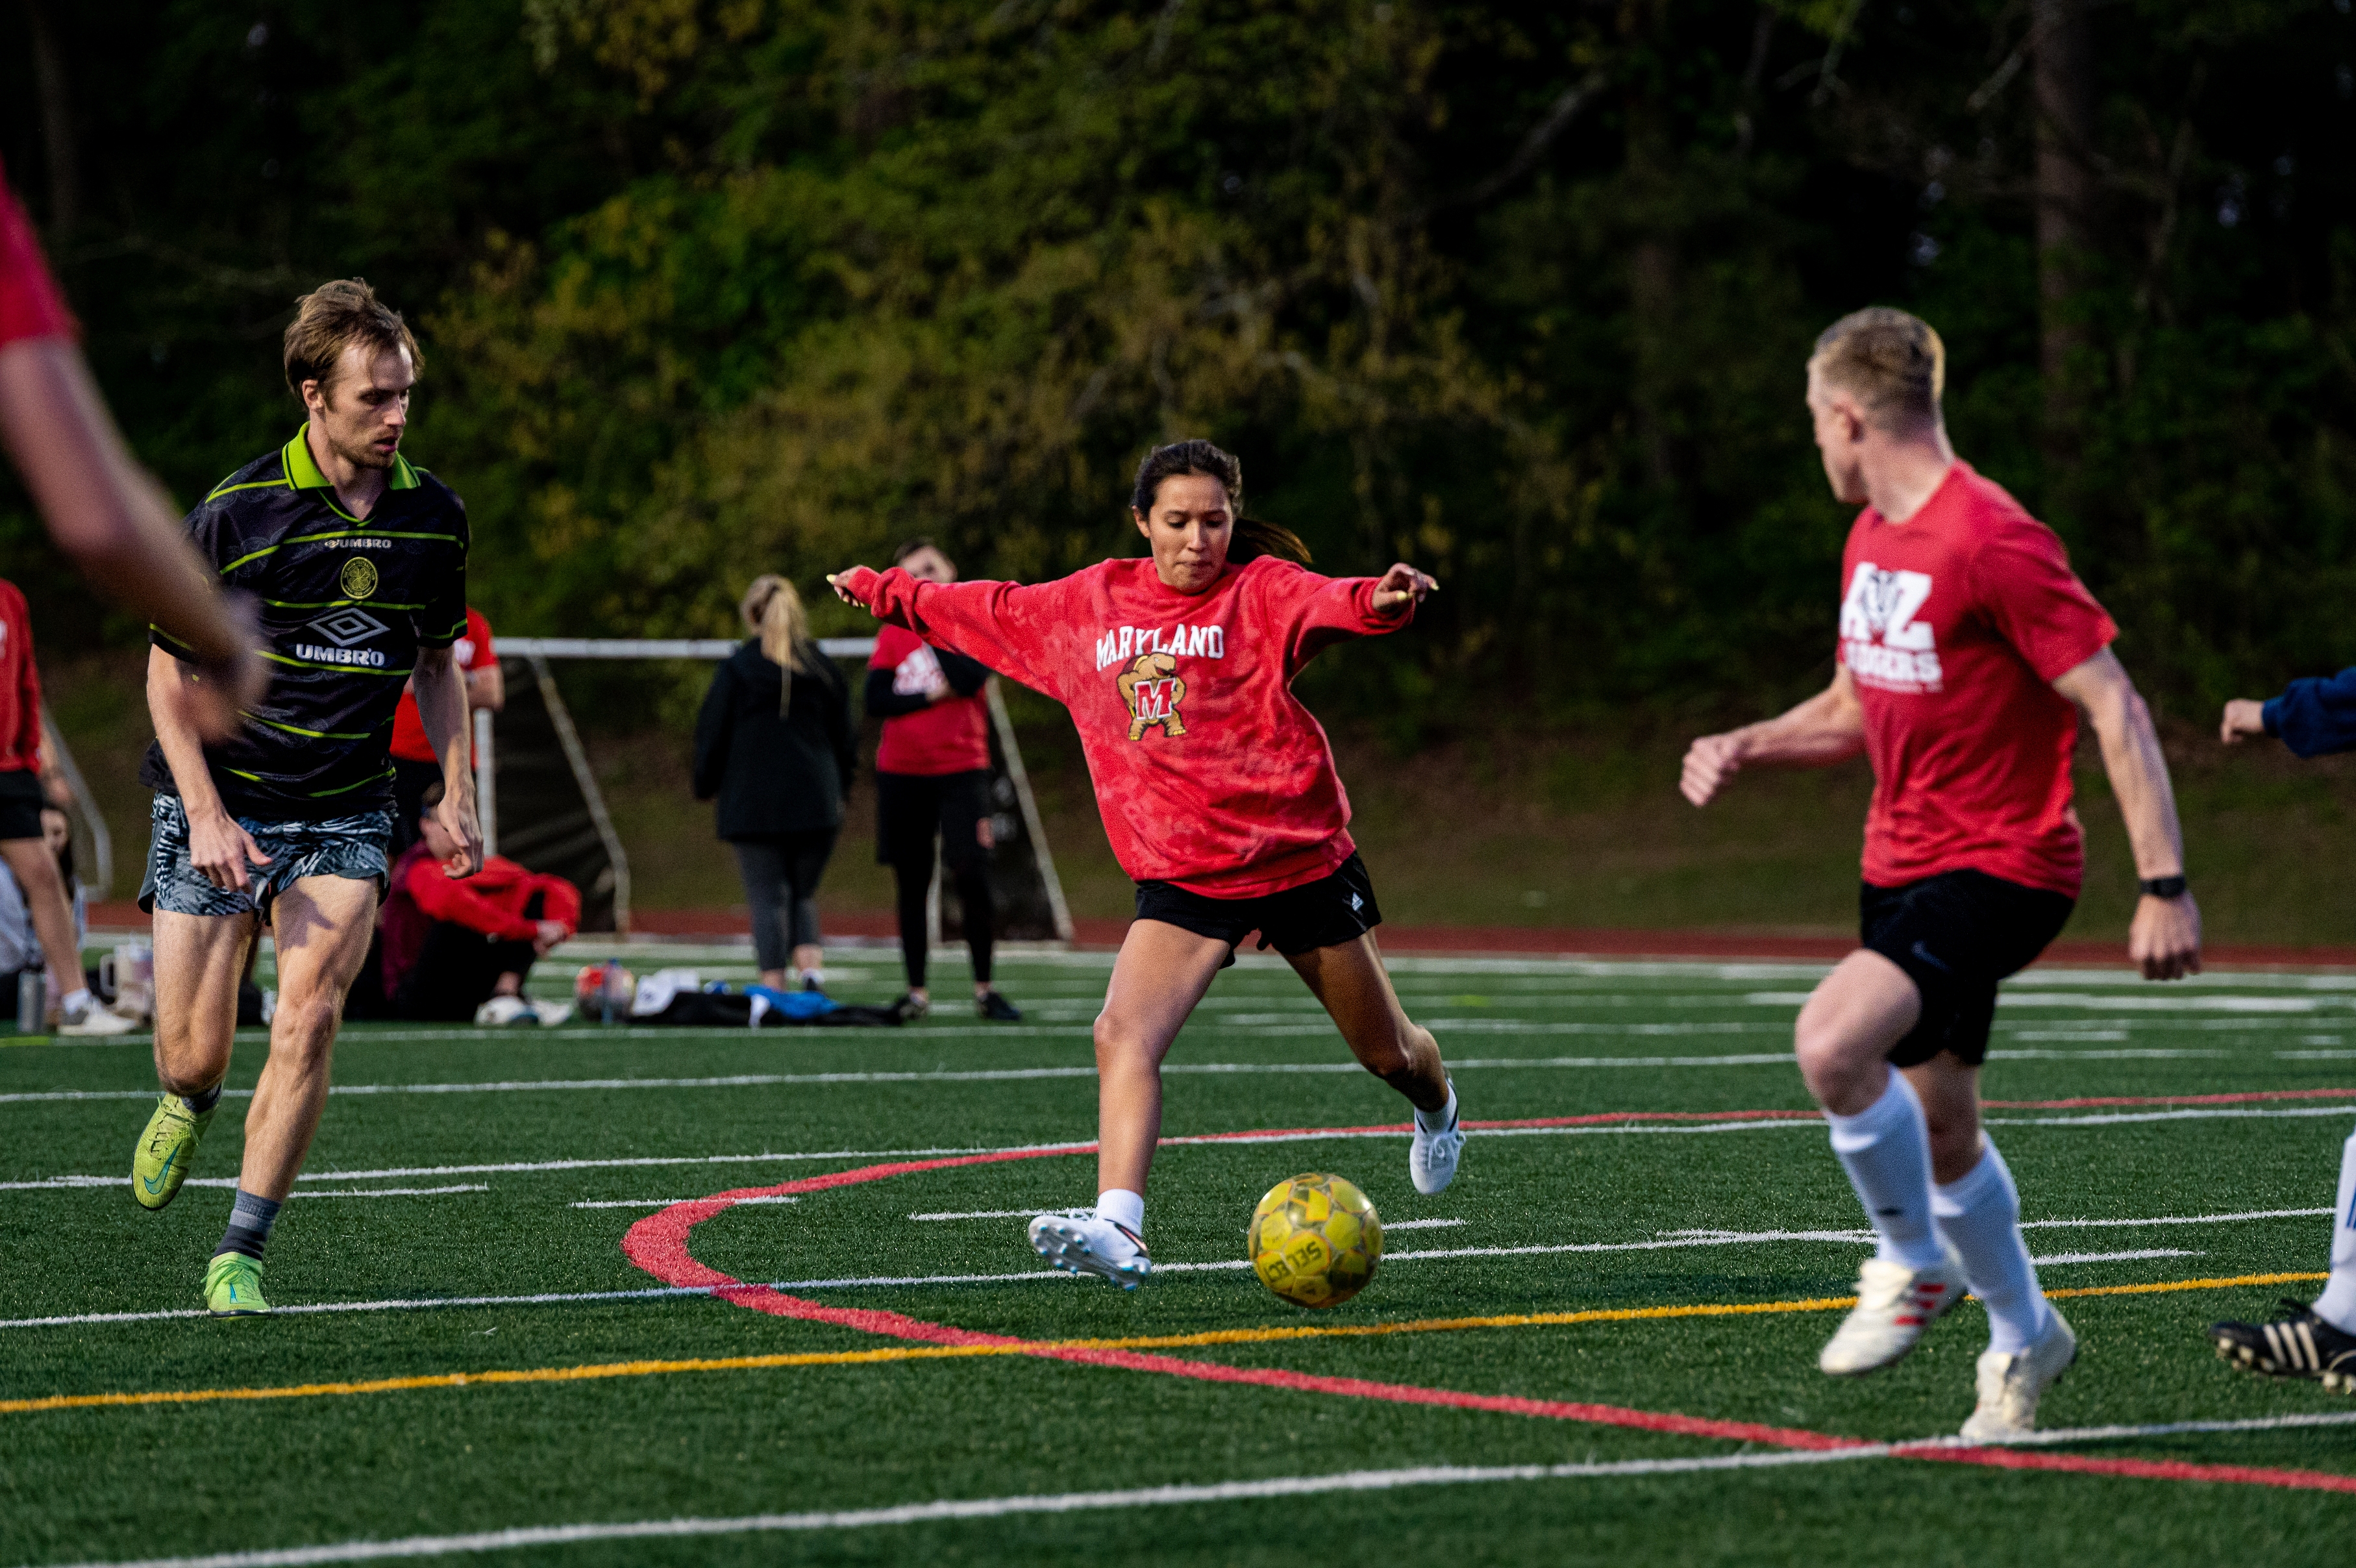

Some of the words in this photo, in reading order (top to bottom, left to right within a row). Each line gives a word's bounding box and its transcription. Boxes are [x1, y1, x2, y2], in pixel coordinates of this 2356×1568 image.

[339, 538, 392, 549] UMBRO
[296, 643, 385, 667] UMBRO
[1095, 623, 1224, 671] MARYLAND
[1134, 677, 1176, 721] M
[1263, 1240, 1322, 1283] SELECT
